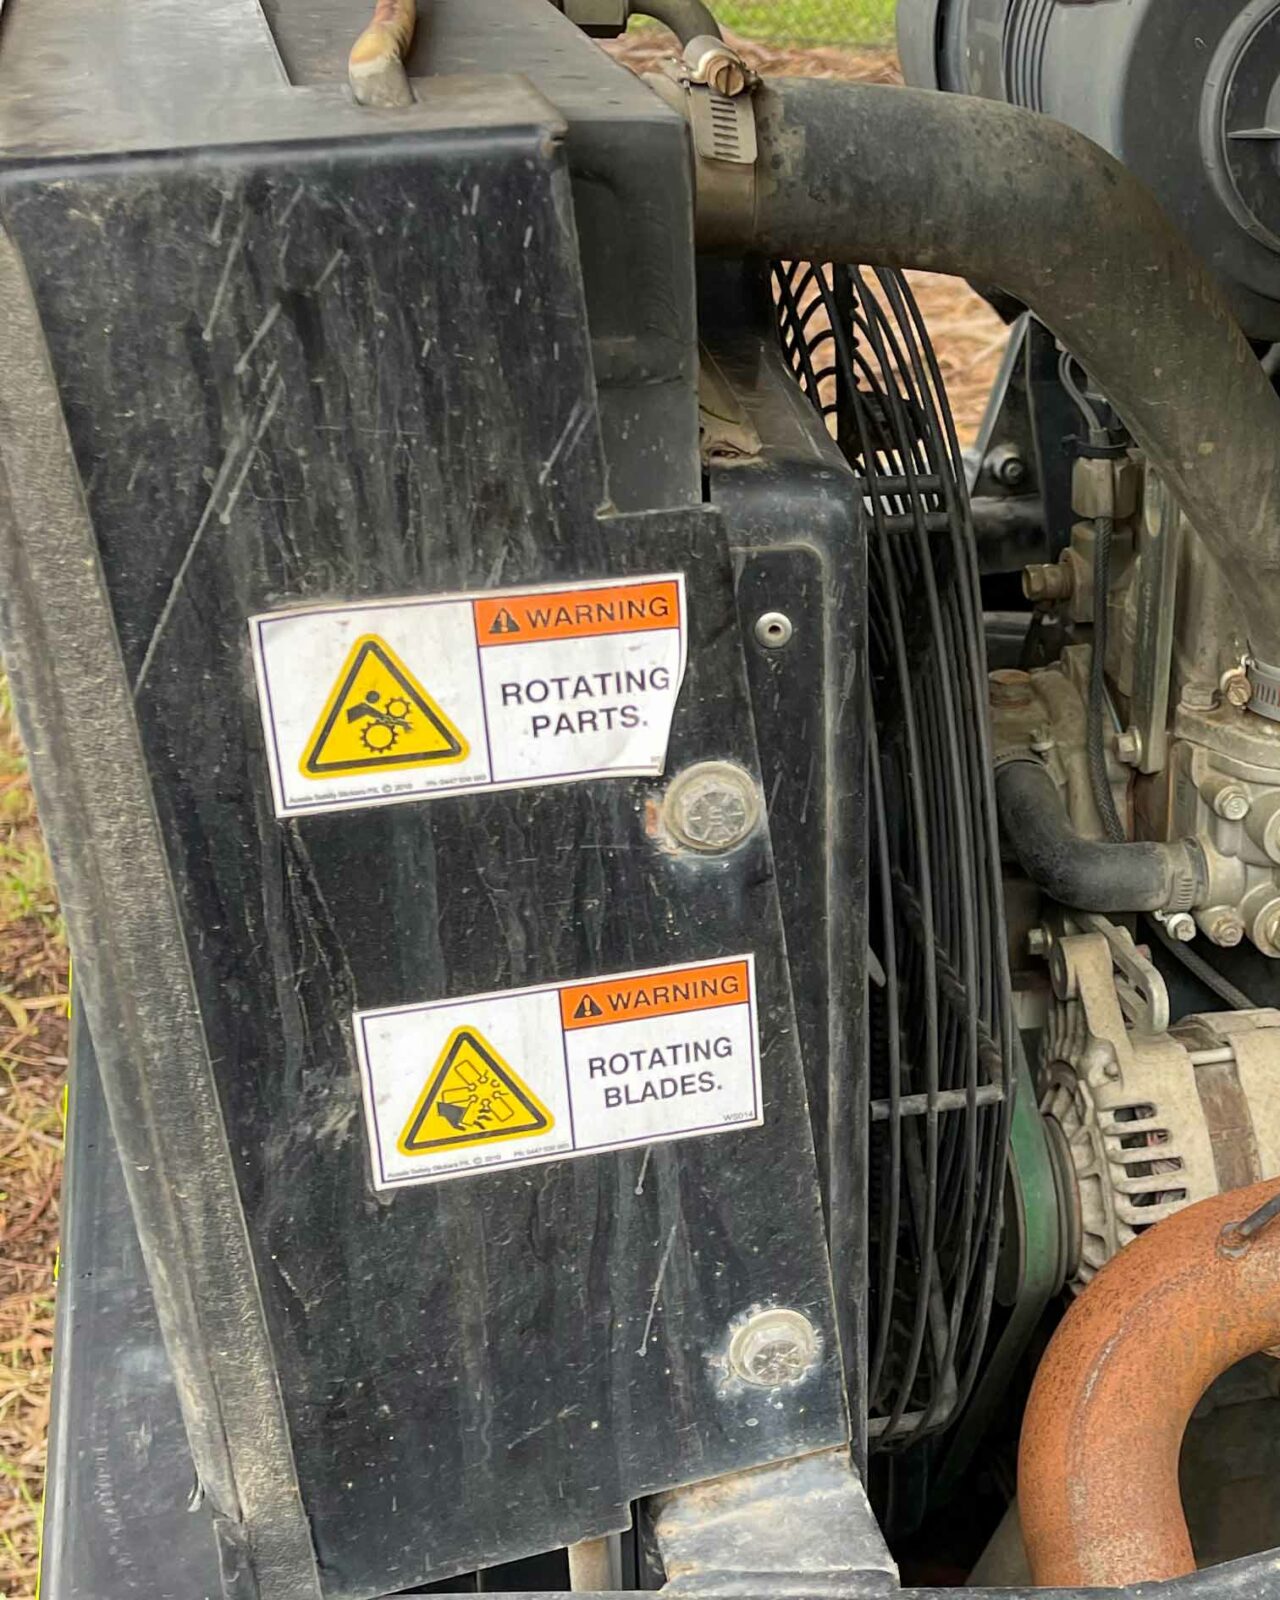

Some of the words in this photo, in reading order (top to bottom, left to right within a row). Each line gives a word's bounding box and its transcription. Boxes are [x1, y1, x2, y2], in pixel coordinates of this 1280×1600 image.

[526, 597, 669, 628] WARNING
[501, 667, 670, 706] ROTATING
[532, 705, 648, 738] PARTS.
[607, 976, 739, 1011] WARNING
[588, 1037, 733, 1078] ROTATING
[604, 1071, 722, 1108] BLADES.
